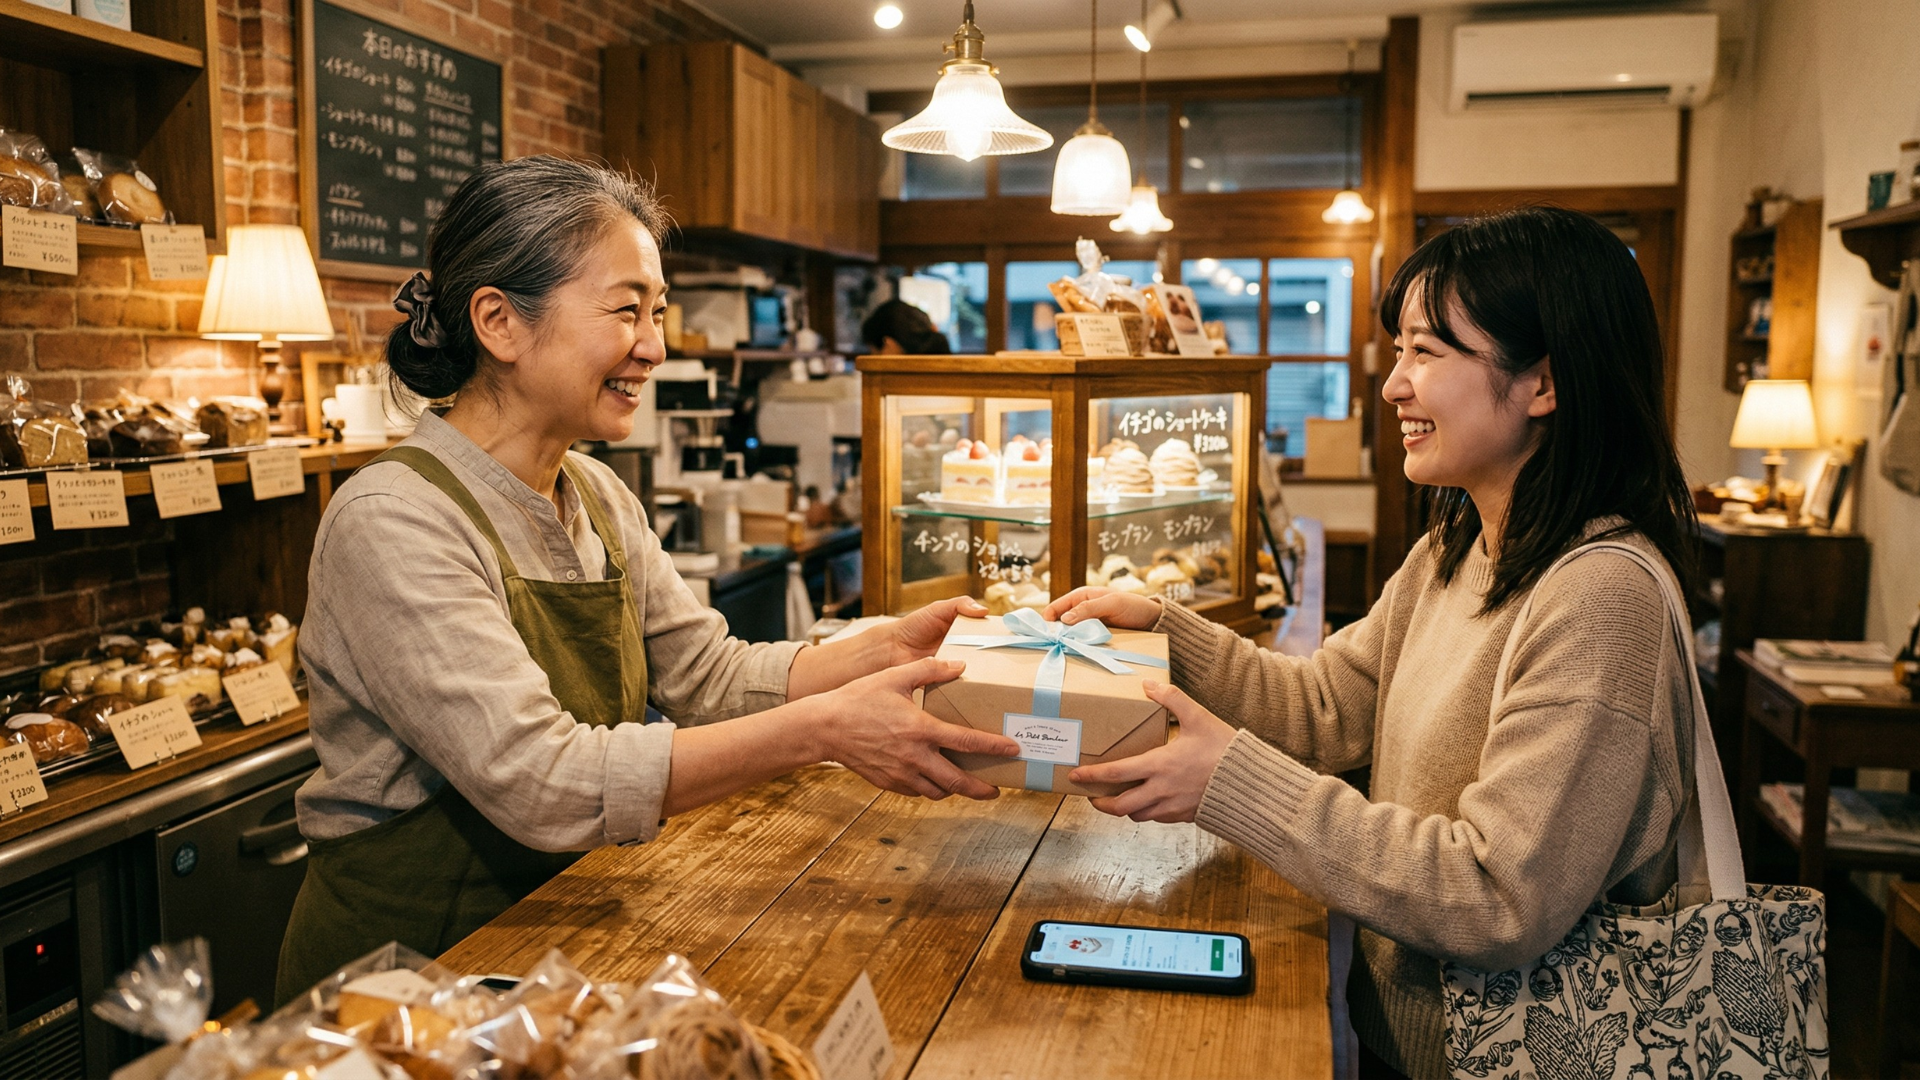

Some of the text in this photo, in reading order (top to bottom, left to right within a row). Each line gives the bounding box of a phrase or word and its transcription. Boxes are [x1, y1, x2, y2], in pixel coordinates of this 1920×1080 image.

[362, 28, 458, 82] 本日のおすすめ
[1118, 405, 1228, 437] イチゴのショートケーキ
